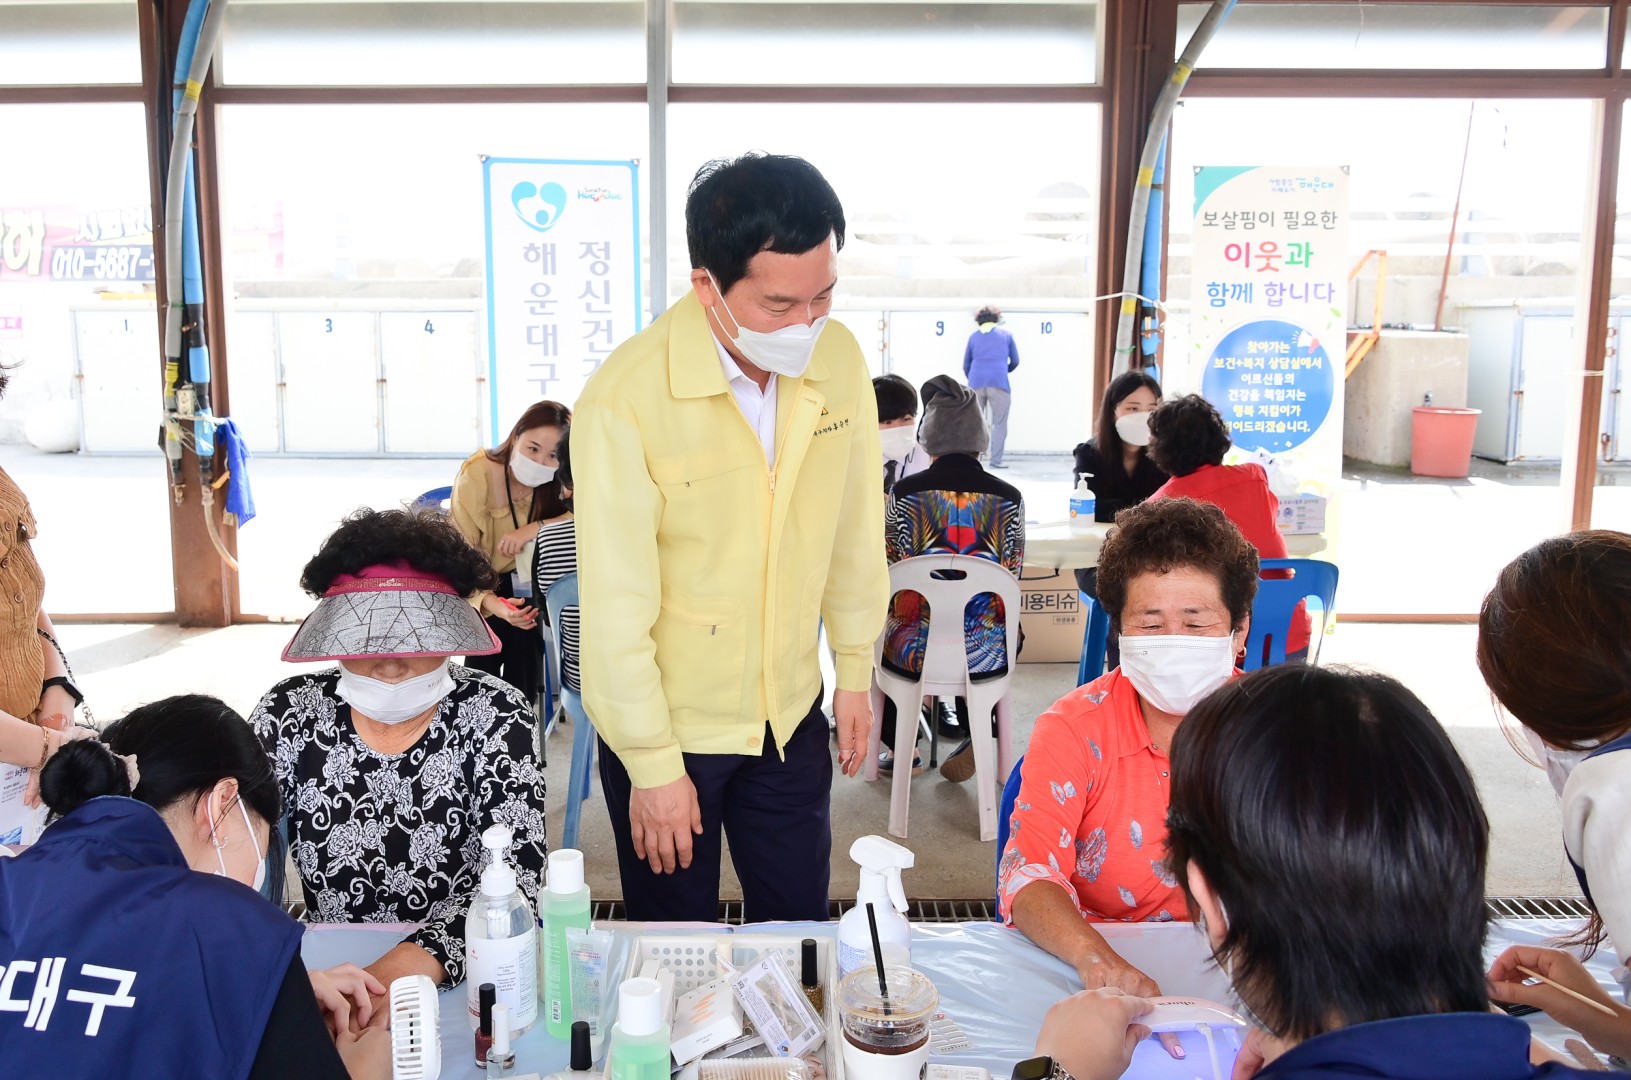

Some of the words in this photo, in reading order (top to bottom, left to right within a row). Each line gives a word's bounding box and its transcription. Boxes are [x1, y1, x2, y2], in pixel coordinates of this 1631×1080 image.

[1202, 210, 1275, 230] 보살핌이
[1283, 210, 1338, 230] 필요한
[1224, 241, 1314, 272] 이웃과
[1206, 282, 1253, 307] 함께
[1264, 282, 1335, 307] 합니다
[325, 318, 333, 333] 3
[424, 319, 435, 334] 4
[523, 242, 560, 396] 해운대구
[935, 321, 945, 336] 9
[1041, 321, 1053, 334] 10
[1247, 340, 1291, 353] 찾아가는
[1268, 357, 1322, 369] 상담실에서
[1241, 373, 1295, 386] 어르신들의
[1228, 389, 1261, 402] 건강을
[1263, 389, 1307, 402] 책임지는
[1233, 405, 1255, 418] 행복
[1258, 405, 1302, 418] 지킴이가
[0, 956, 138, 1037] 대구
